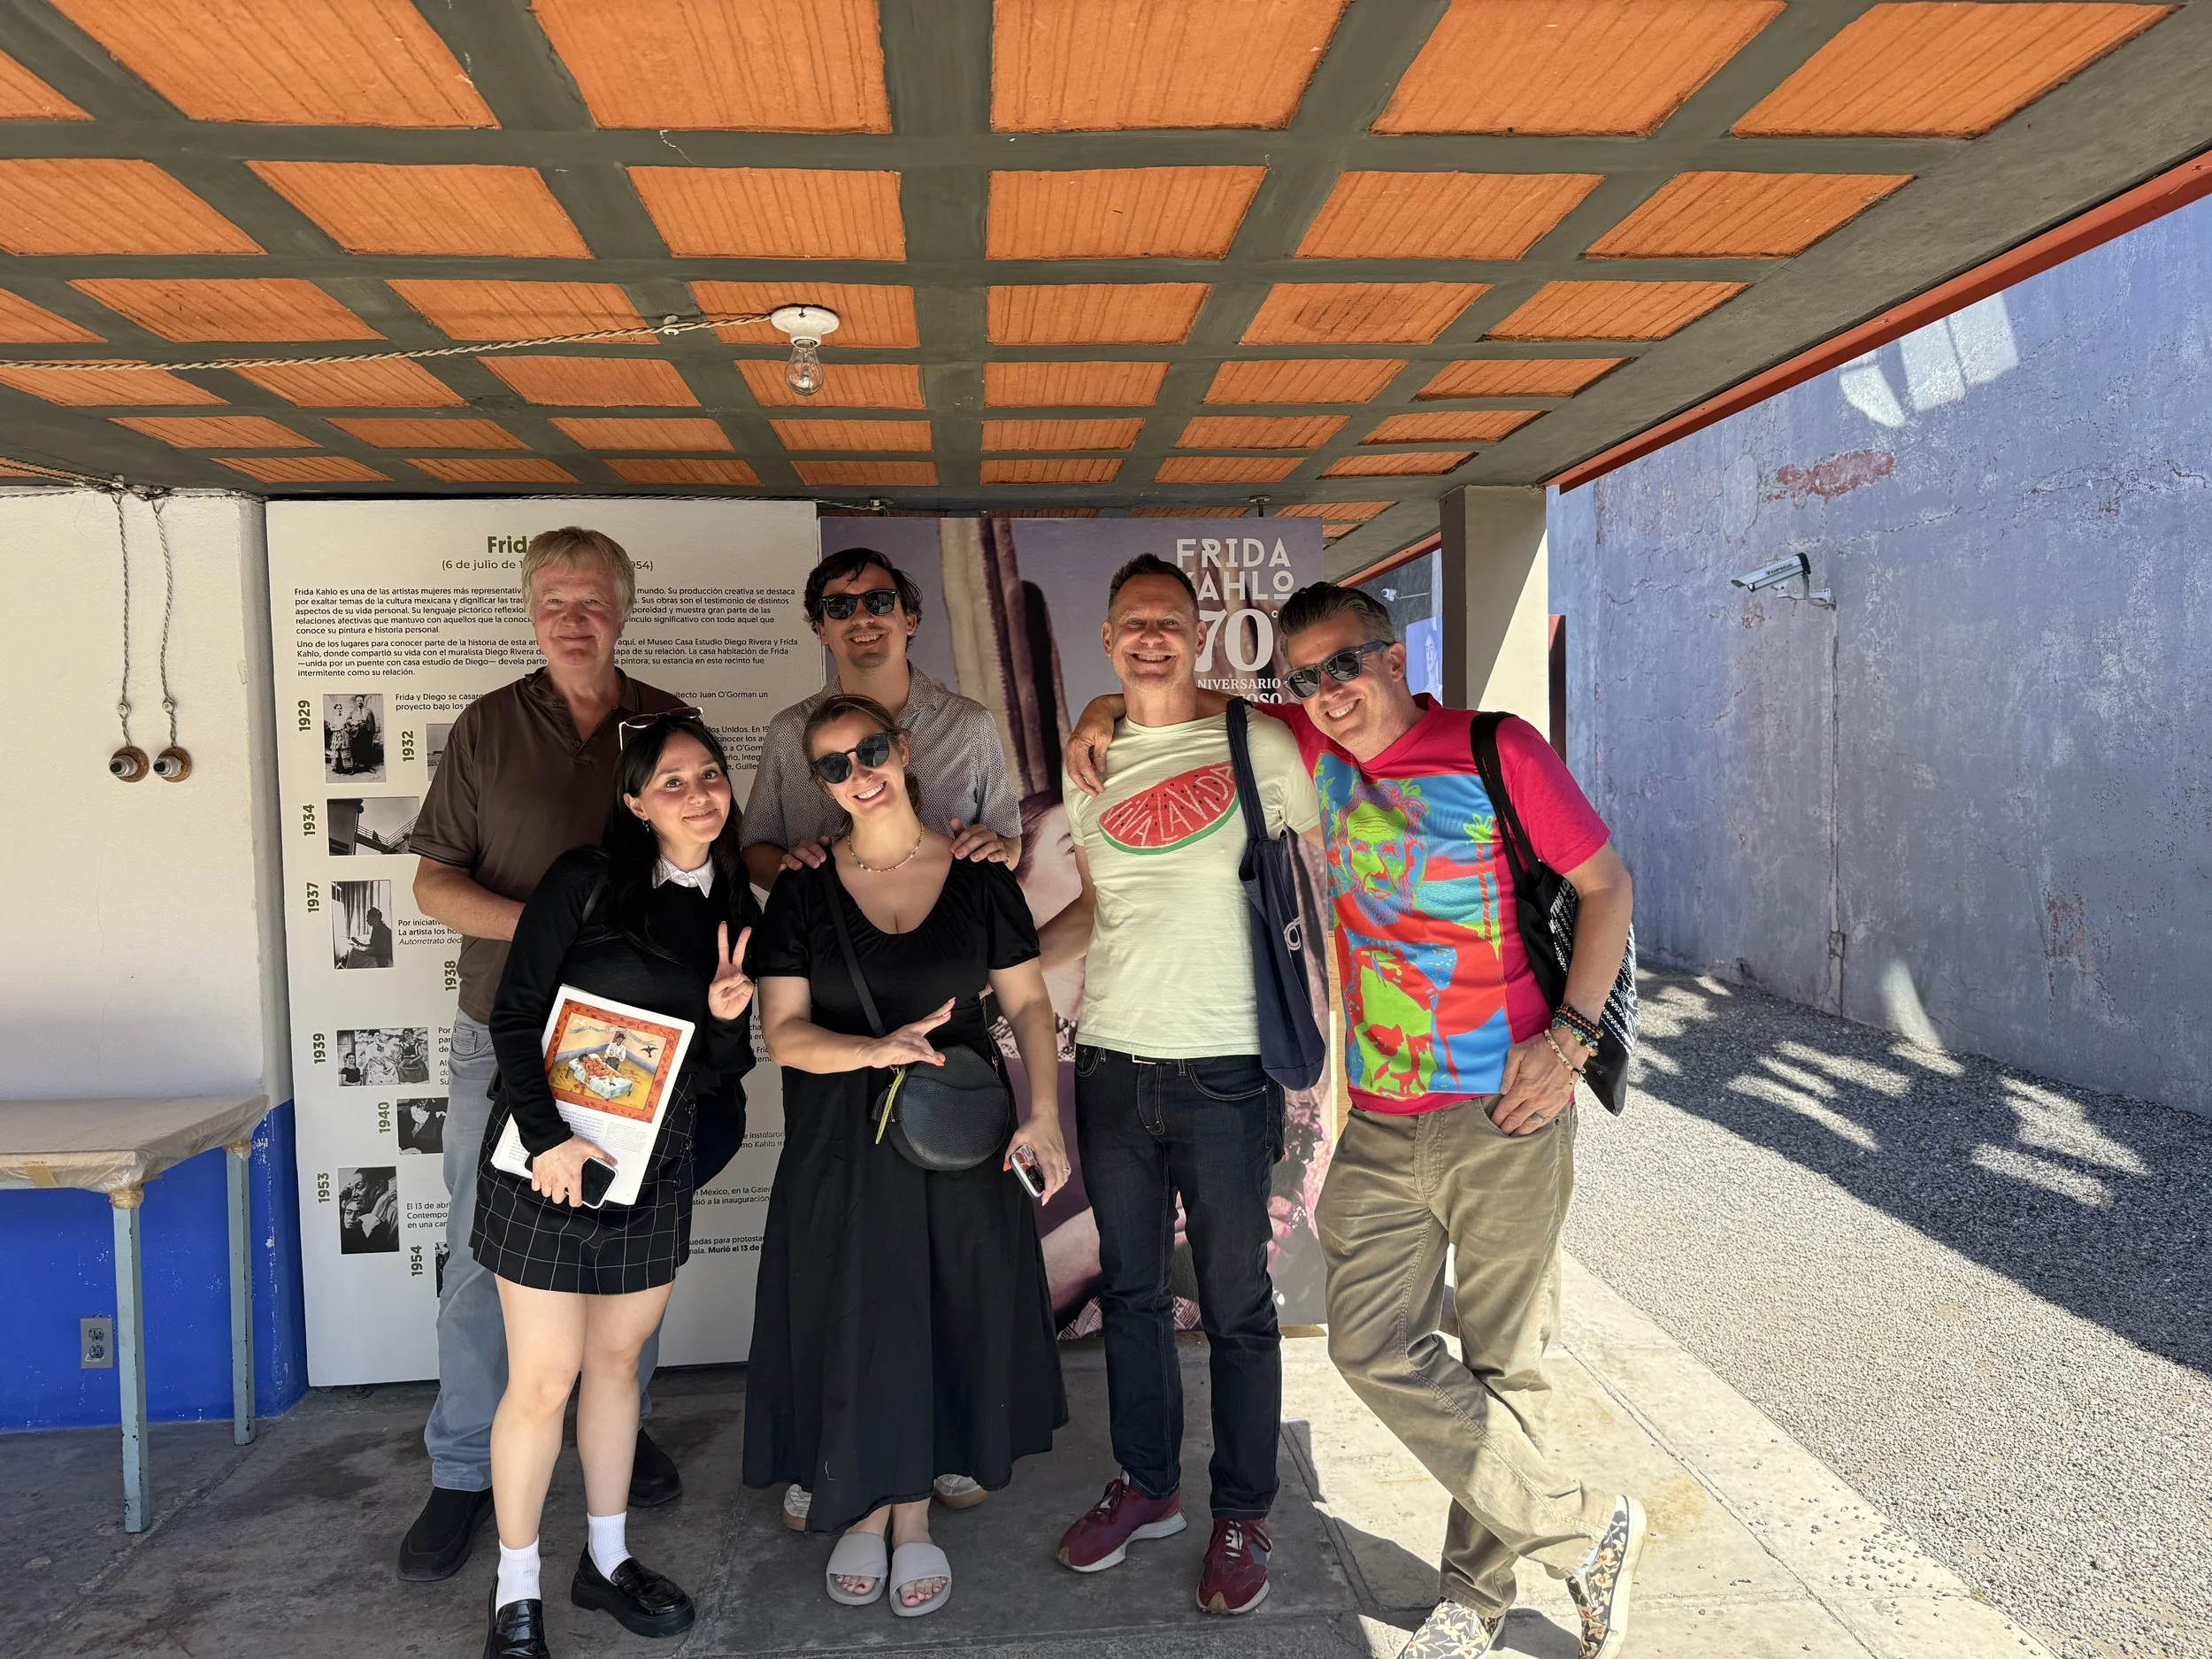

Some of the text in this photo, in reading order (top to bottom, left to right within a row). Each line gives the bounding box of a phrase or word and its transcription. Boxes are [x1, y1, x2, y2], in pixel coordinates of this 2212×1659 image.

[487, 536, 532, 553] Frid
[1176, 538, 1291, 568] FRIDA
[442, 560, 453, 571] (6
[456, 560, 470, 569] de
[473, 560, 498, 570] julio
[501, 560, 516, 569] de
[632, 561, 653, 571] 954)
[421, 587, 452, 596] mujeres
[471, 587, 523, 596] representativ
[679, 587, 723, 596] producción
[1186, 571, 1294, 600] AHLO
[460, 597, 496, 605] dignificar
[374, 607, 410, 616] personal.
[423, 607, 457, 615] lenguaje
[458, 606, 493, 615] pictórico
[443, 616, 476, 625] aquellos
[654, 616, 699, 624] significativo
[737, 616, 758, 624] aquel
[338, 627, 366, 635] pintura
[405, 626, 440, 635] personal.
[341, 640, 370, 649] lugares
[724, 639, 747, 647] Diego
[351, 649, 392, 658] compartió
[485, 648, 508, 657] Diego
[1197, 678, 1281, 689] NIVERSARIO
[423, 693, 447, 702] Diego
[433, 703, 451, 711] bajo
[298, 700, 311, 731] 1929
[402, 730, 415, 762] 1932
[303, 804, 315, 836] 1934
[307, 882, 320, 913] 1937
[444, 960, 457, 991] 1938
[313, 1033, 326, 1064] 1939
[378, 1102, 390, 1133] 1940
[317, 1173, 330, 1203] 1953
[708, 1245, 730, 1253] Murió
[410, 1245, 423, 1276] 1954
